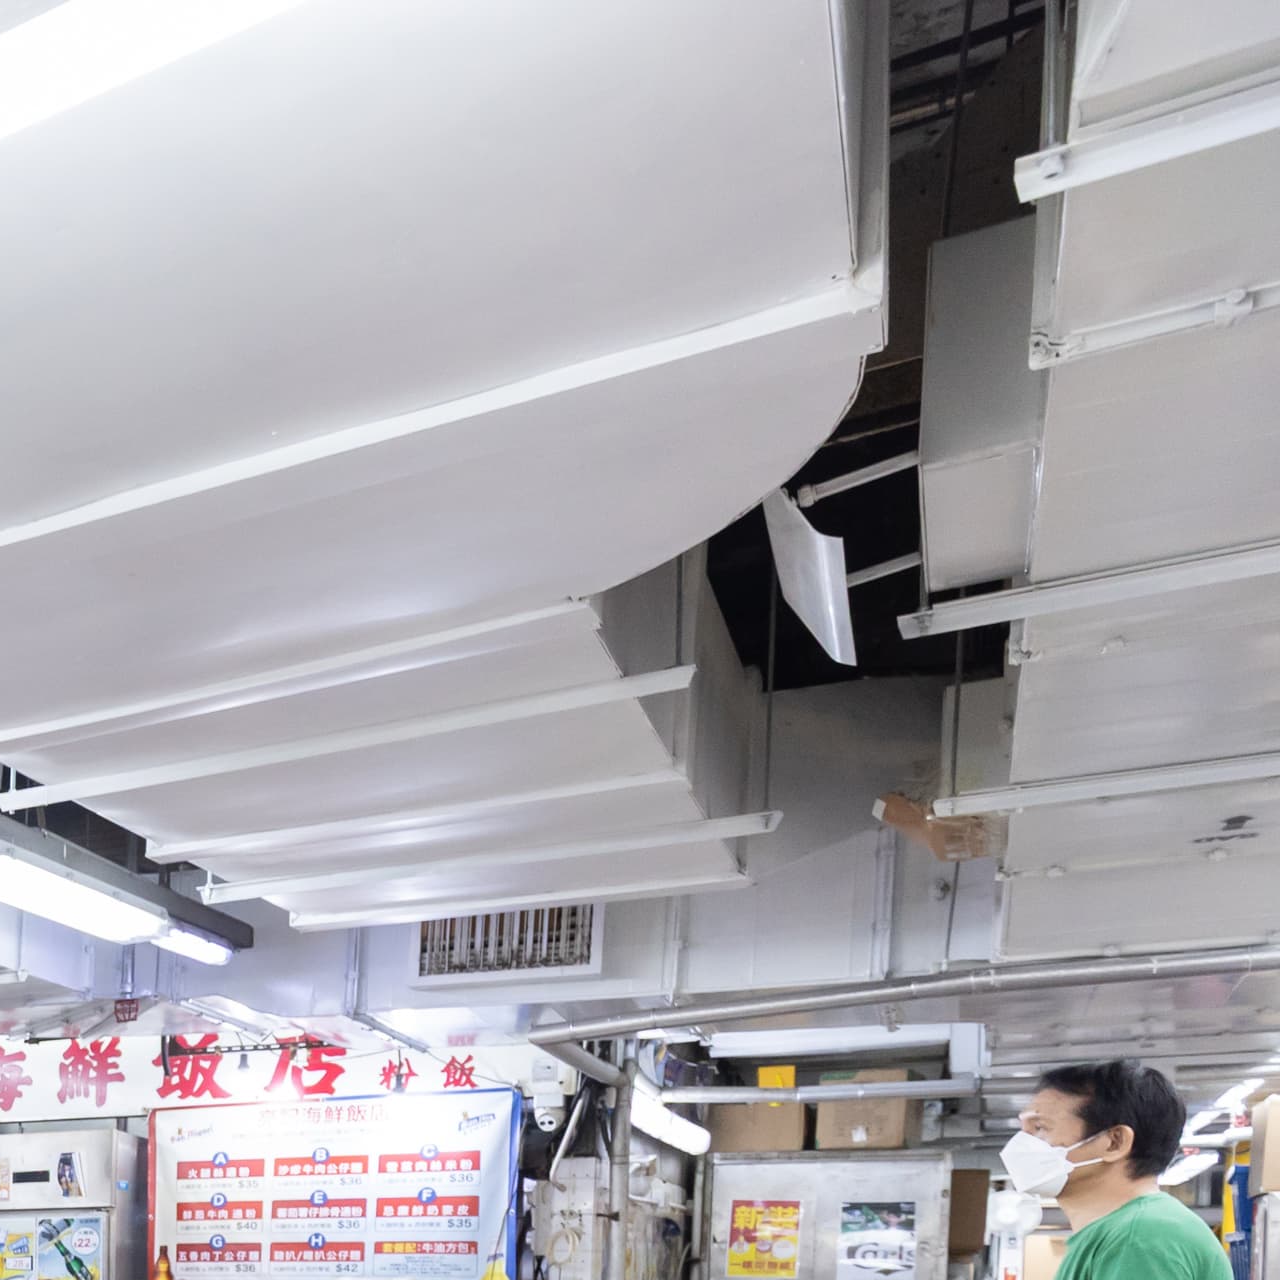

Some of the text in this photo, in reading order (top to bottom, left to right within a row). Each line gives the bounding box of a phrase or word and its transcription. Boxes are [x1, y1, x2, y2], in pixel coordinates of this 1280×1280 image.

[449, 1173, 474, 1183] $36
[236, 1222, 258, 1230] $40
[337, 1220, 360, 1229] $36
[447, 1218, 472, 1229] $35
[235, 1264, 256, 1273] $36
[335, 1263, 359, 1273] $42
